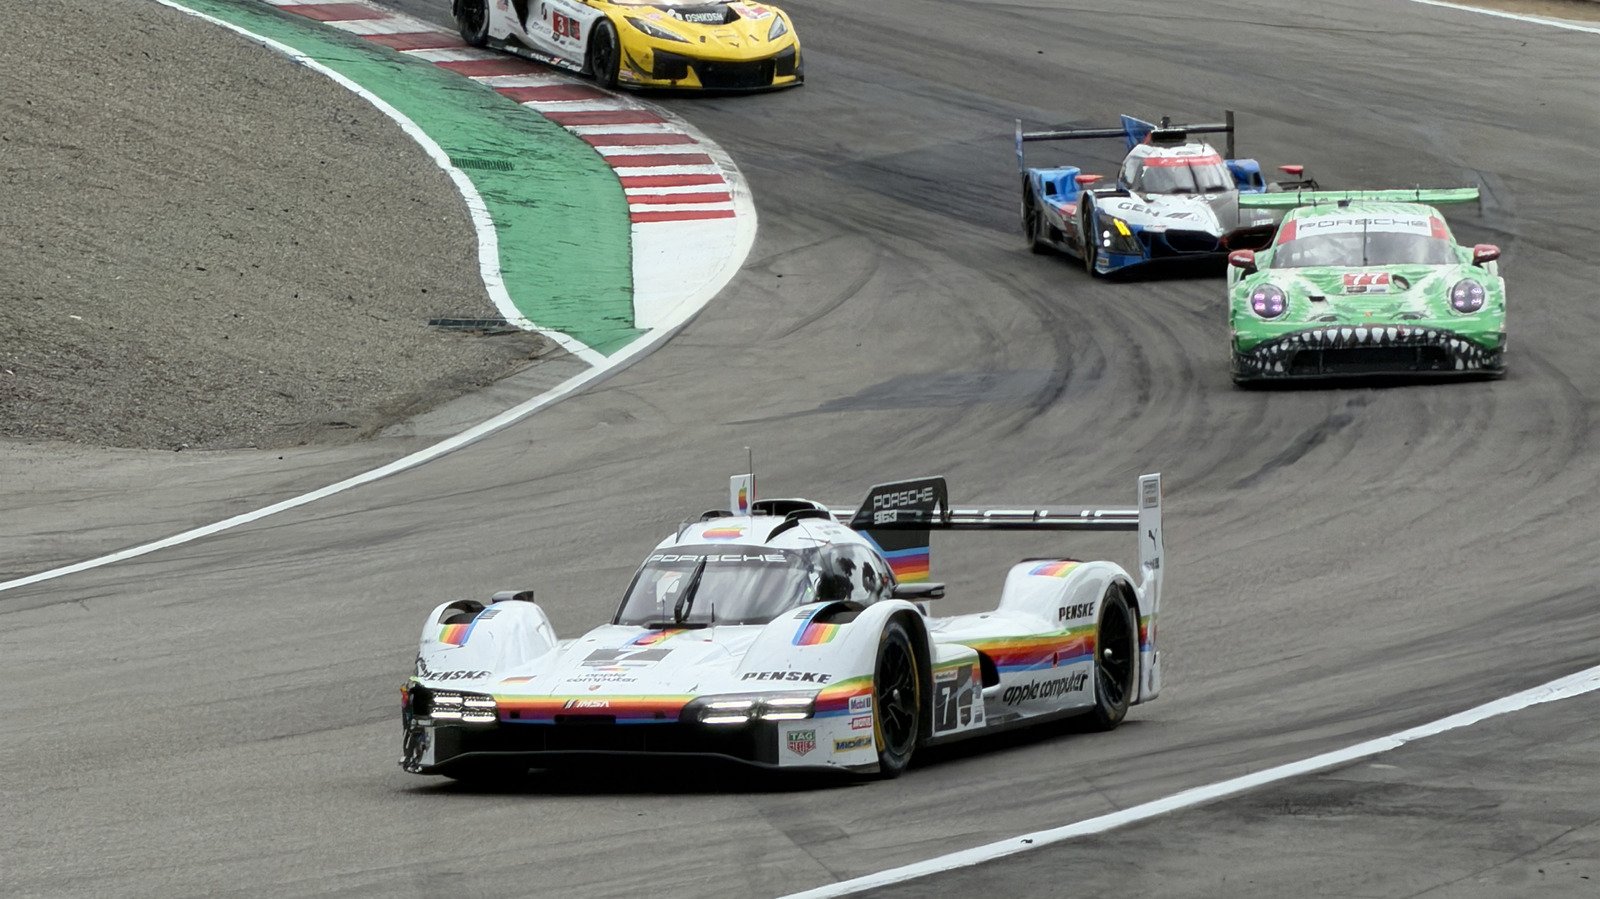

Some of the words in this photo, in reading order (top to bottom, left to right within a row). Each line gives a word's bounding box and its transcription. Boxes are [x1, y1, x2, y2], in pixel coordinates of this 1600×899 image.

[557, 16, 565, 33] 3
[1299, 219, 1428, 230] PORSCHE
[1350, 272, 1384, 285] 77
[874, 487, 933, 510] PORSCHE
[874, 510, 897, 524] 963
[648, 554, 787, 562] PORSCHE
[1058, 602, 1095, 621] PENSKE
[741, 671, 832, 684] PENSKE
[1003, 679, 1040, 706] apple
[1039, 671, 1089, 700] computer
[941, 687, 951, 725] 7
[790, 731, 813, 740] TAG
